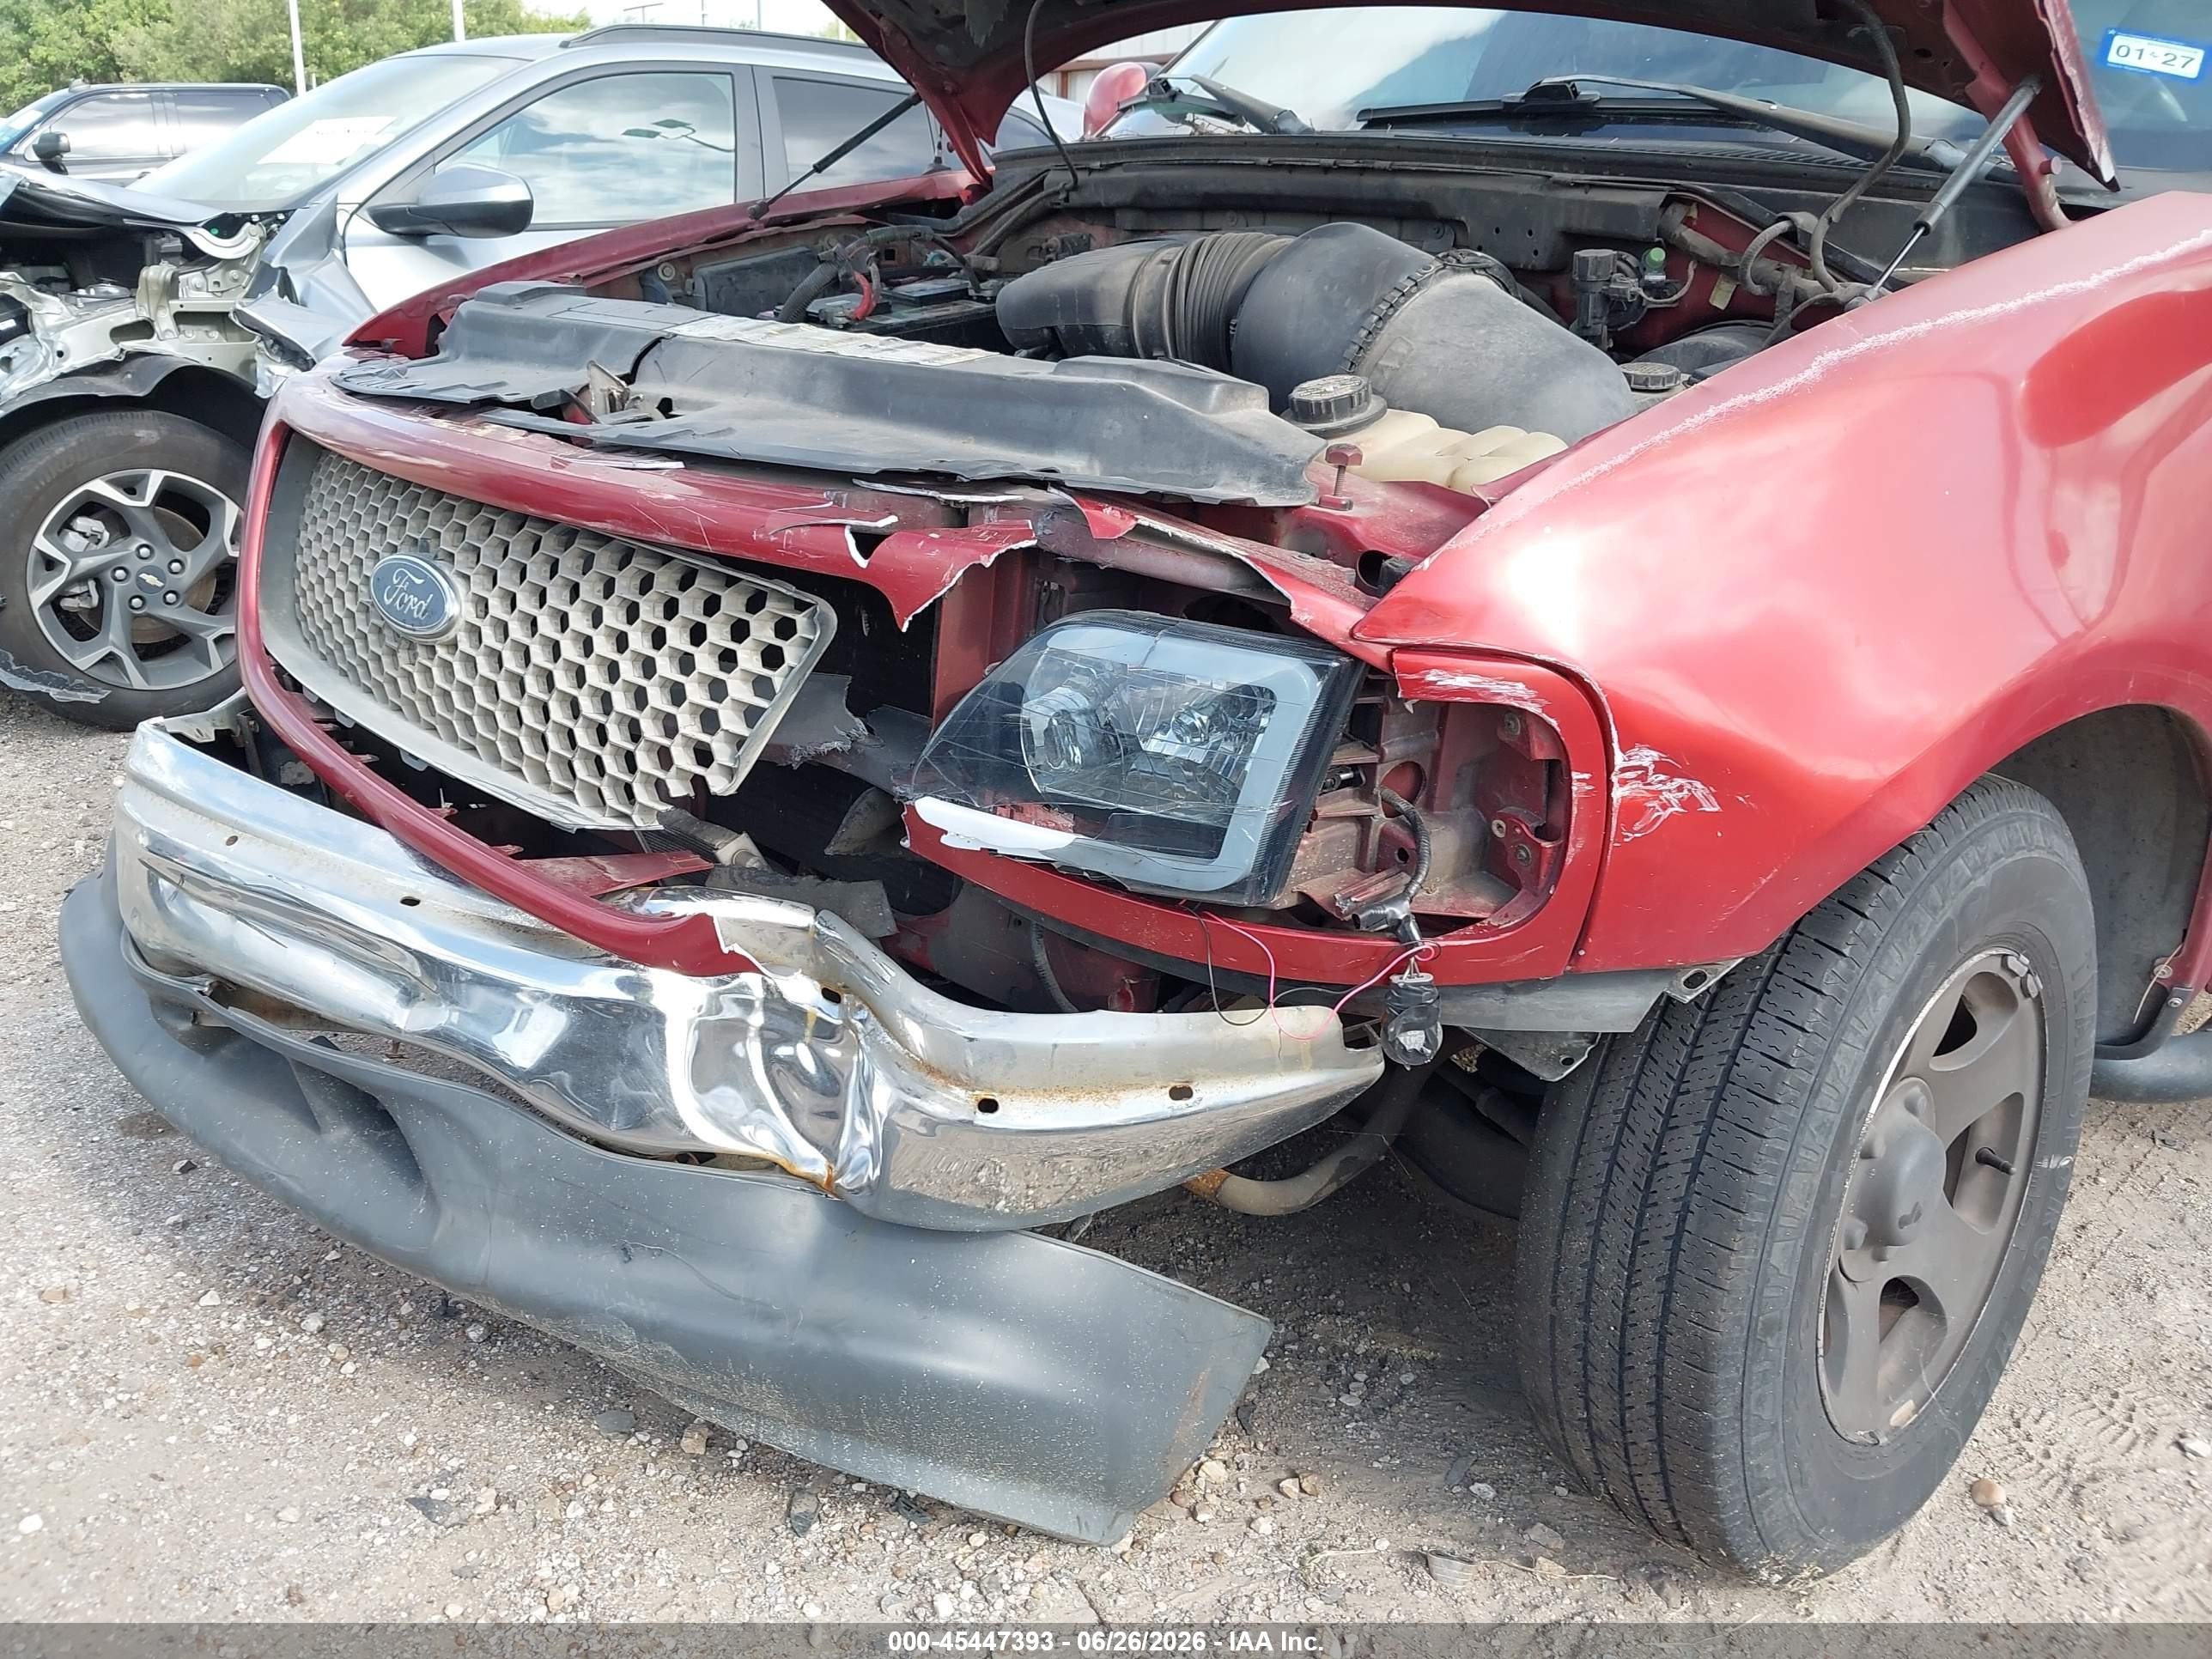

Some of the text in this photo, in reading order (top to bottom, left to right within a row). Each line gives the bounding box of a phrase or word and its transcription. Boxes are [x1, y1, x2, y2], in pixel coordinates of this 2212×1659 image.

[2116, 45, 2145, 61] 01
[2160, 52, 2196, 69] 27
[383, 568, 434, 620] Ford
